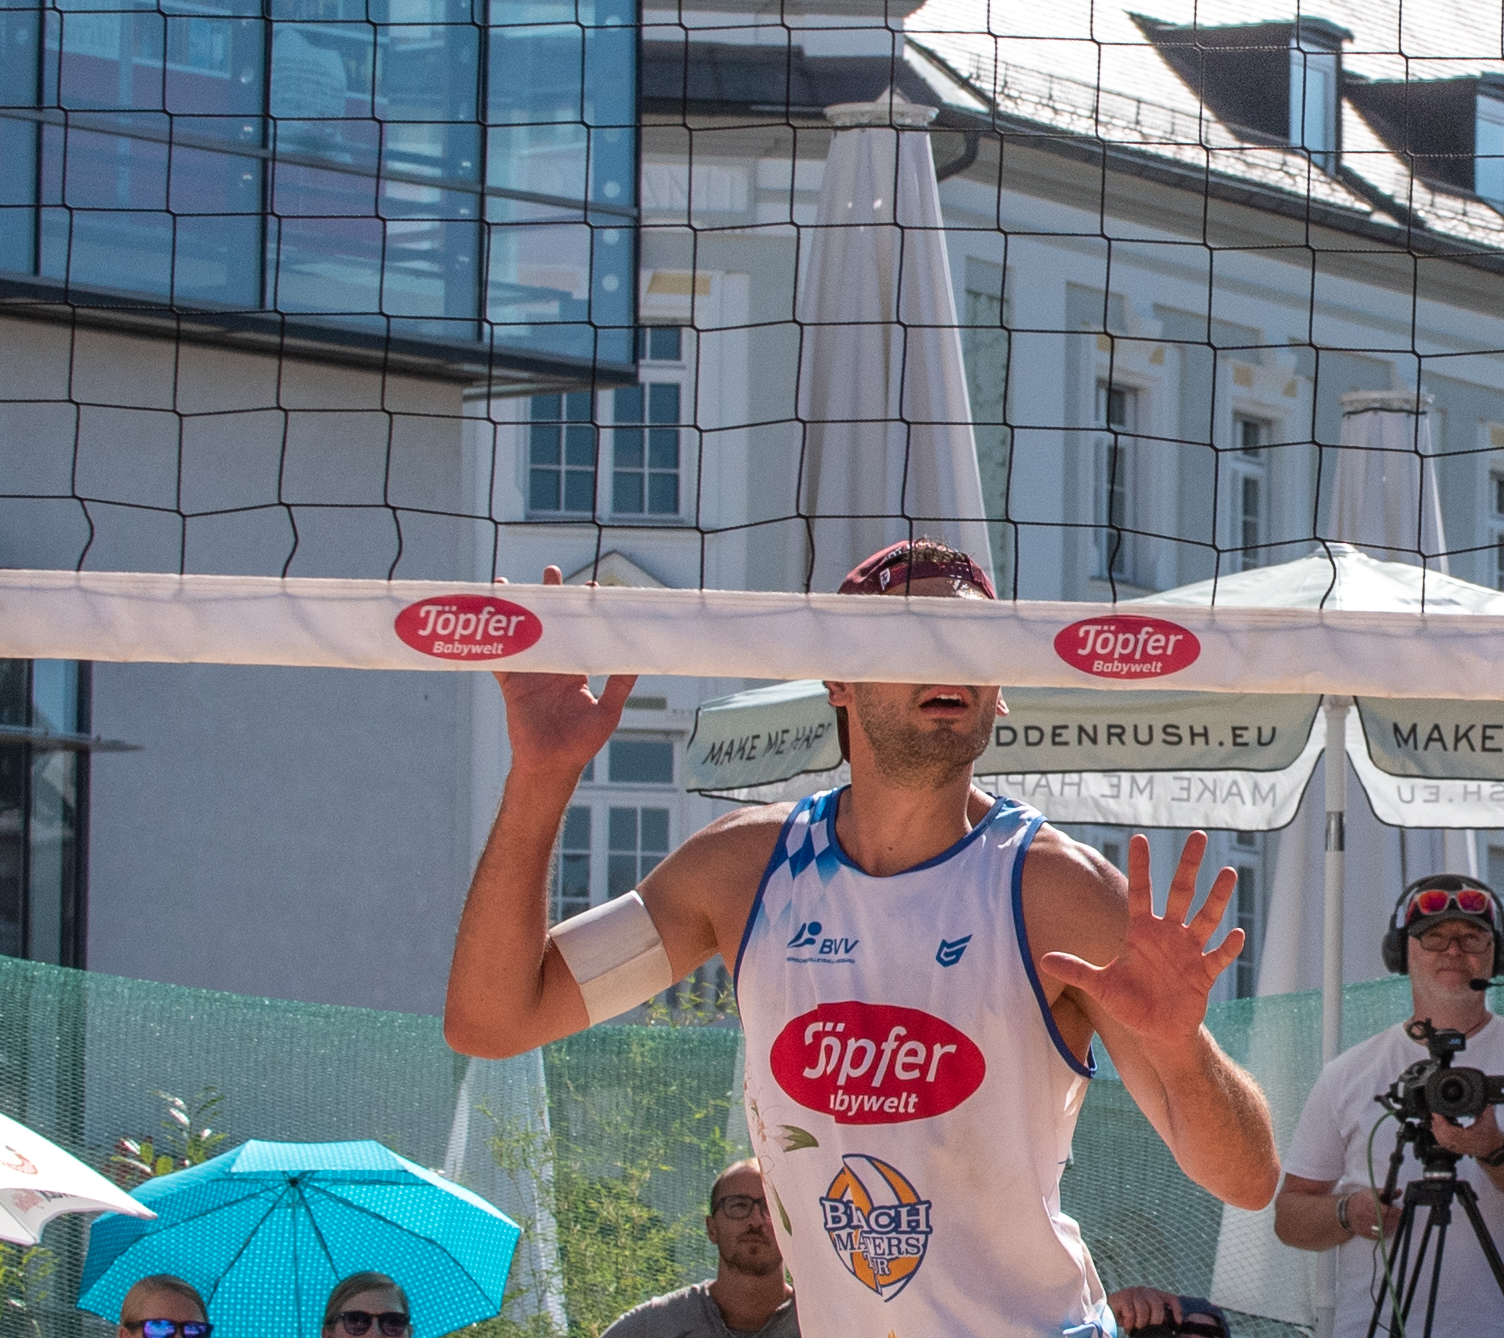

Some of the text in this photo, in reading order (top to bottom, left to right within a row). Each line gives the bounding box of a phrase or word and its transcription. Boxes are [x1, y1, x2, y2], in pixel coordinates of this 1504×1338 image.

[1077, 624, 1184, 660] Töpfer
[1092, 659, 1163, 675] Babywelt
[702, 733, 761, 766] MAKE
[763, 728, 790, 758] ME
[995, 723, 1278, 748] DDENRUSH.EU
[1392, 721, 1504, 754] MAKE
[818, 937, 859, 956] BVV
